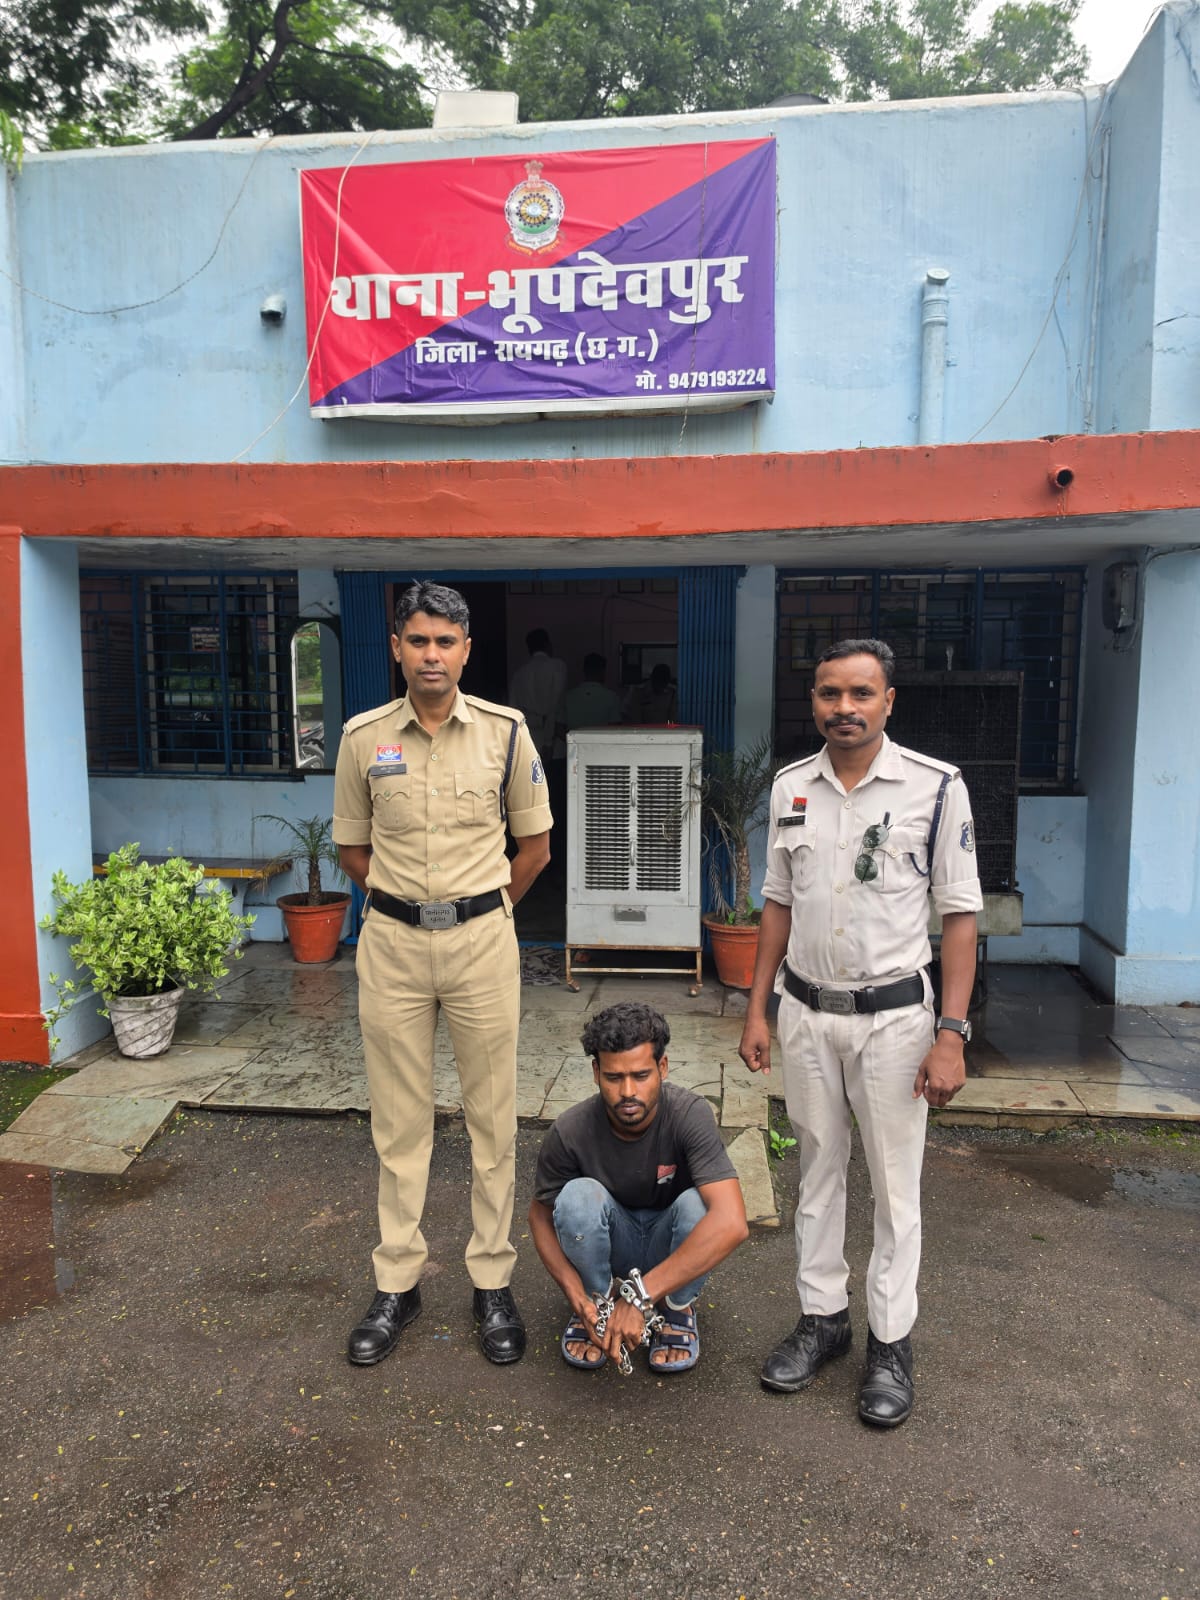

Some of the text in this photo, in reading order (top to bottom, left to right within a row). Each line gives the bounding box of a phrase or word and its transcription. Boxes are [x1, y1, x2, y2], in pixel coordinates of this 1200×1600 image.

[331, 251, 749, 335] थाना-भूपदेवपुर
[415, 328, 659, 367] जिला- रायगढ़ (छ.ग.)
[635, 367, 766, 390] मो. 9479193224
